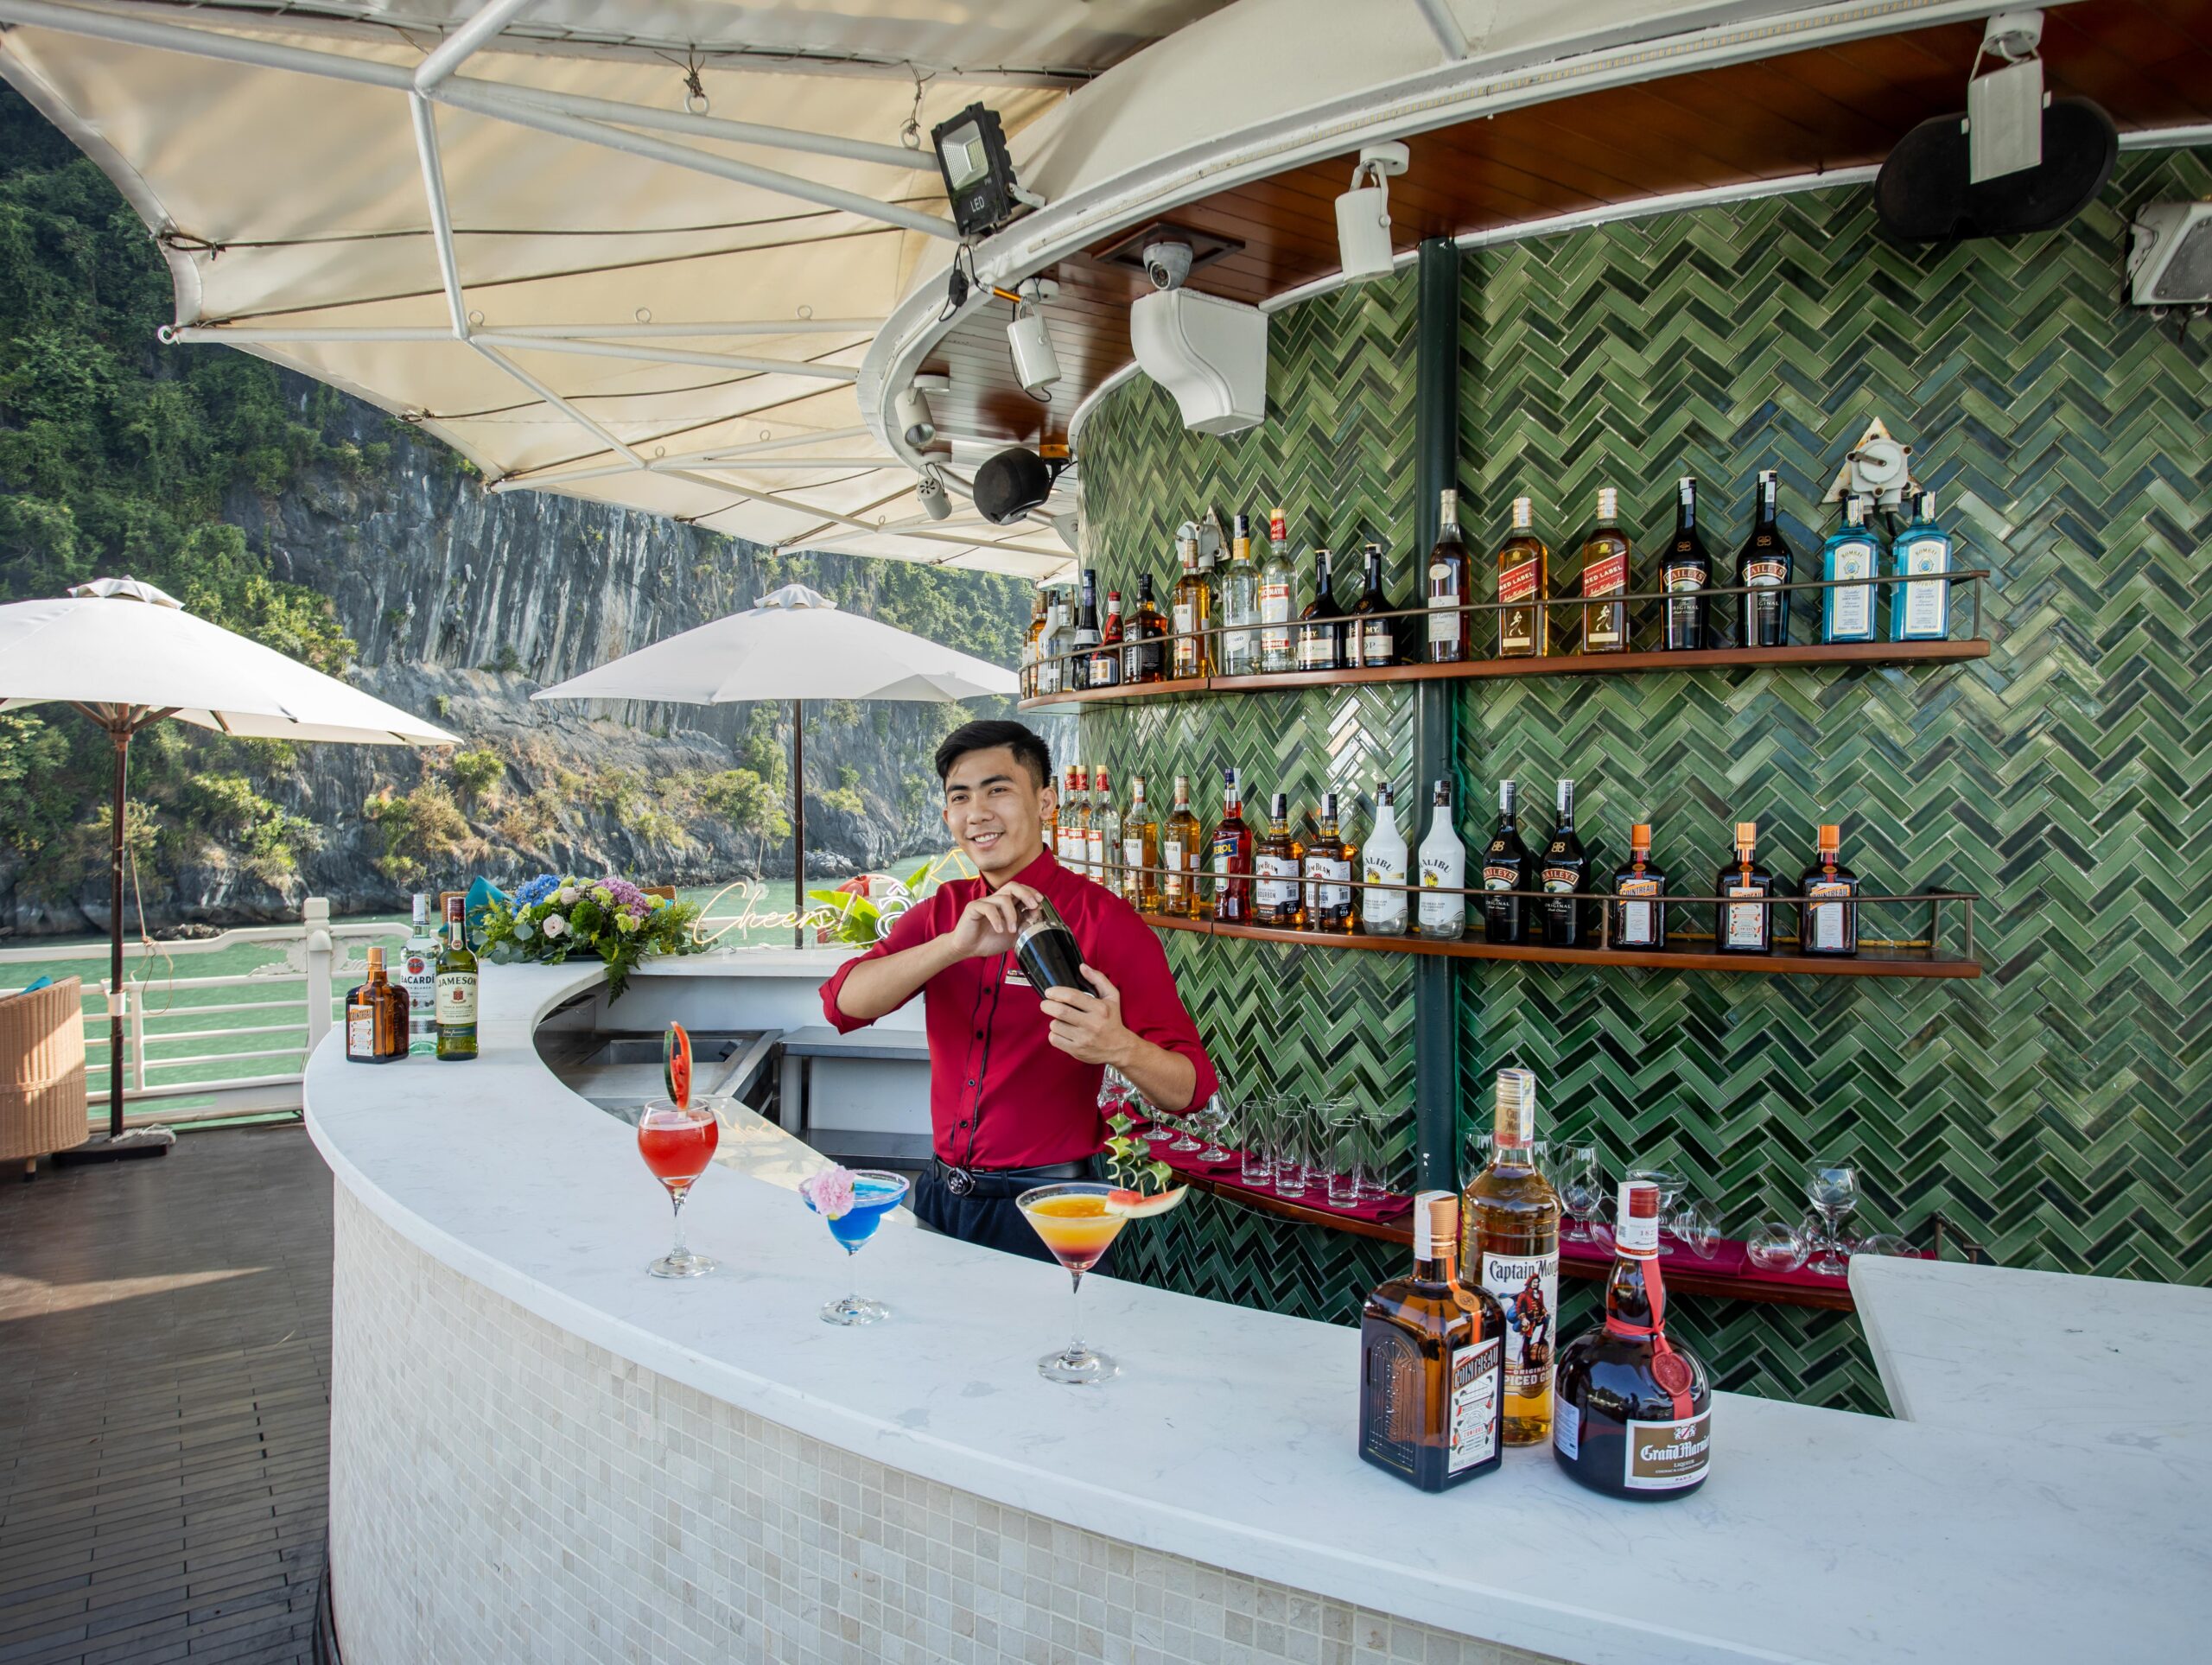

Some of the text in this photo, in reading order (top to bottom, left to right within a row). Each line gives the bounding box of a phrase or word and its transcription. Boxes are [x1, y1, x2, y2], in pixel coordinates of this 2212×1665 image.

[970, 196, 985, 213] LED
[1499, 581, 1512, 591] RED
[1512, 572, 1535, 584] LABEL
[1585, 575, 1599, 584] RED
[1599, 565, 1623, 578] LABEL
[1264, 861, 1278, 874] BEAM
[1315, 862, 1331, 876] BEAM
[1484, 868, 1513, 879] BAILEYS
[1541, 870, 1574, 881] BAILEYS
[693, 881, 856, 944] Cheers!
[438, 976, 477, 988] JAMESON
[1490, 1260, 1535, 1283] Captain
[1454, 1345, 1498, 1389] COINTREAU
[1513, 1364, 1549, 1375] ORIGINAL
[1504, 1375, 1537, 1386] PICED
[1640, 1444, 1681, 1461] Grand
